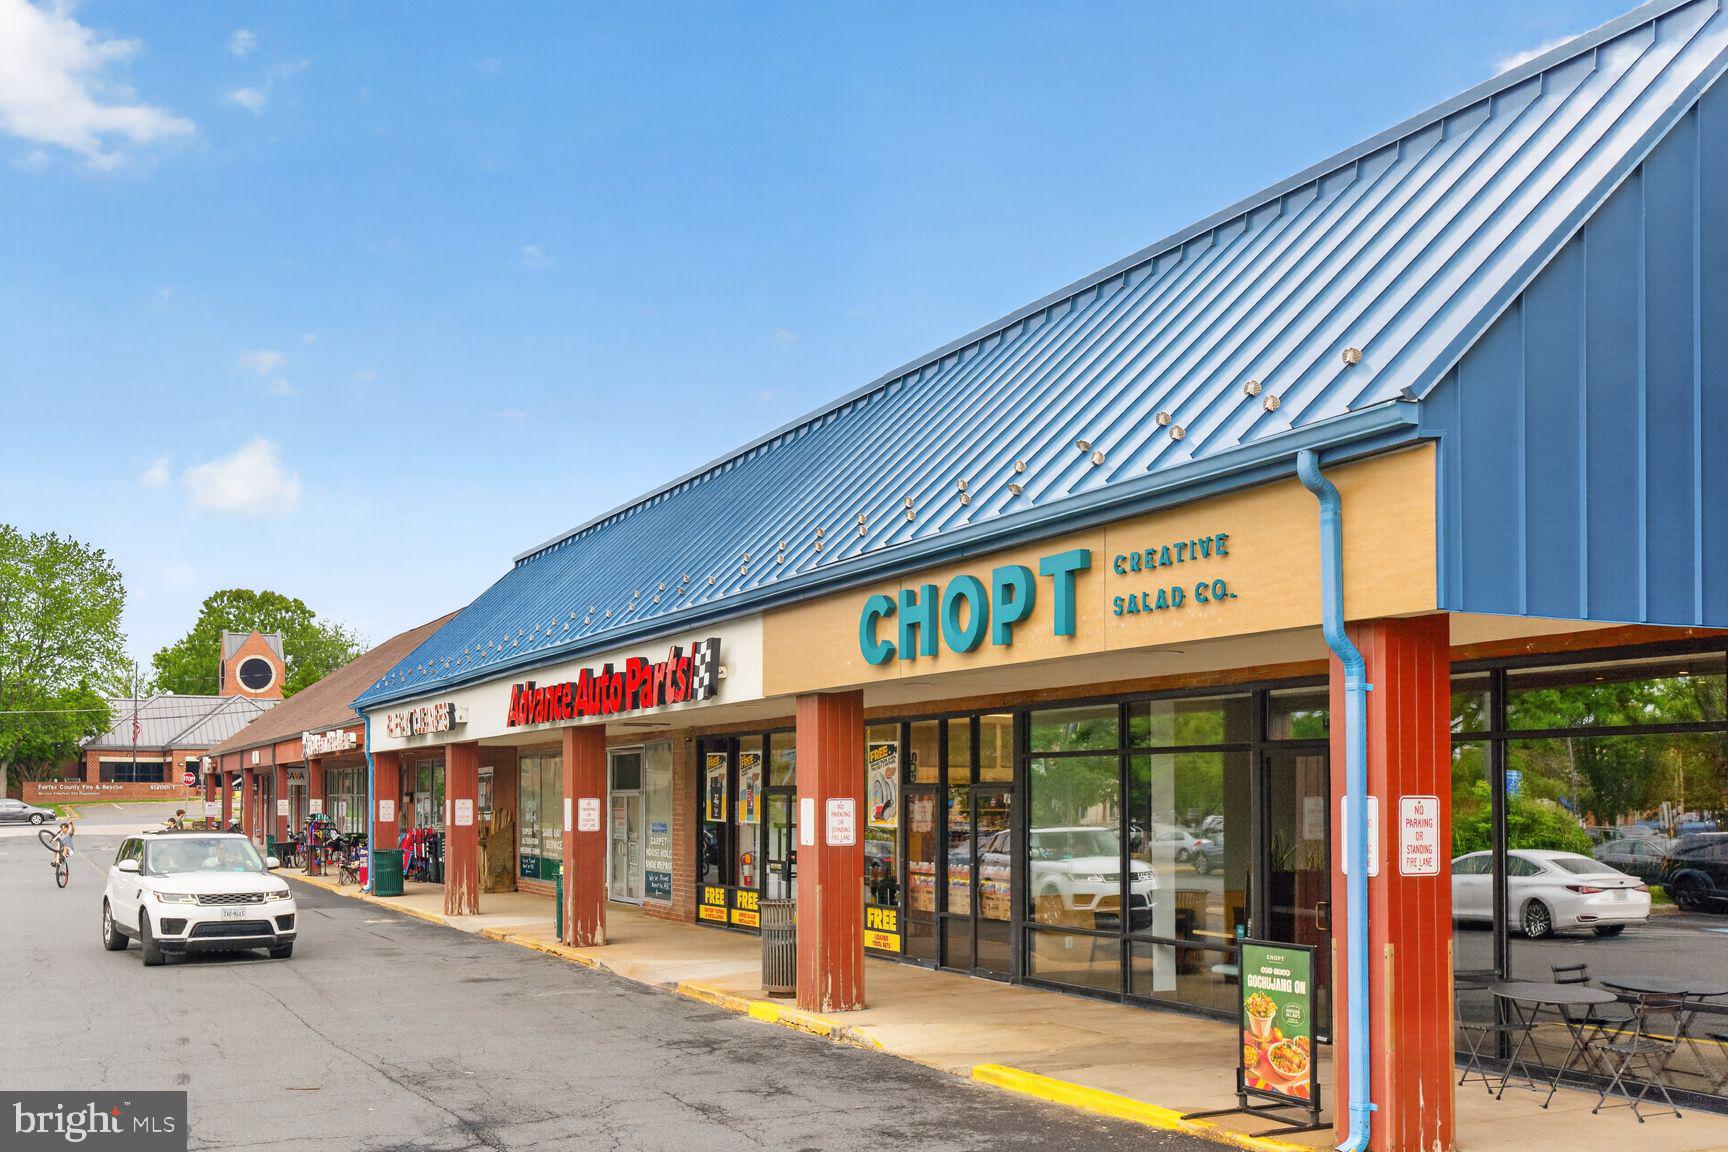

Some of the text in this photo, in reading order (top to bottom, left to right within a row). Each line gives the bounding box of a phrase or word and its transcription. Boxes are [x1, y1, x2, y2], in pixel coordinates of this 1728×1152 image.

[1113, 533, 1230, 576] CREATIVE
[1113, 578, 1238, 616] SALAD CO.
[859, 548, 1092, 665] CHOPT
[507, 646, 689, 727] Advance Auto Parts
[413, 702, 451, 736] CLEANERS
[741, 754, 754, 769] FREE
[870, 745, 889, 762] FREE
[708, 755, 721, 769] FREE
[1414, 805, 1424, 815] NO
[1405, 818, 1433, 828] PARKING
[650, 837, 667, 845] CARPET
[1415, 831, 1424, 840] OR
[545, 840, 563, 850] SERVICE
[1406, 844, 1432, 854] STANDING
[1406, 857, 1432, 867] FIRE LANE
[705, 887, 725, 905] FREE
[737, 890, 758, 910] FREE
[867, 907, 897, 931] FREE
[1266, 954, 1285, 962] CHOPT
[1247, 974, 1306, 994] GOCHUJANG ON
